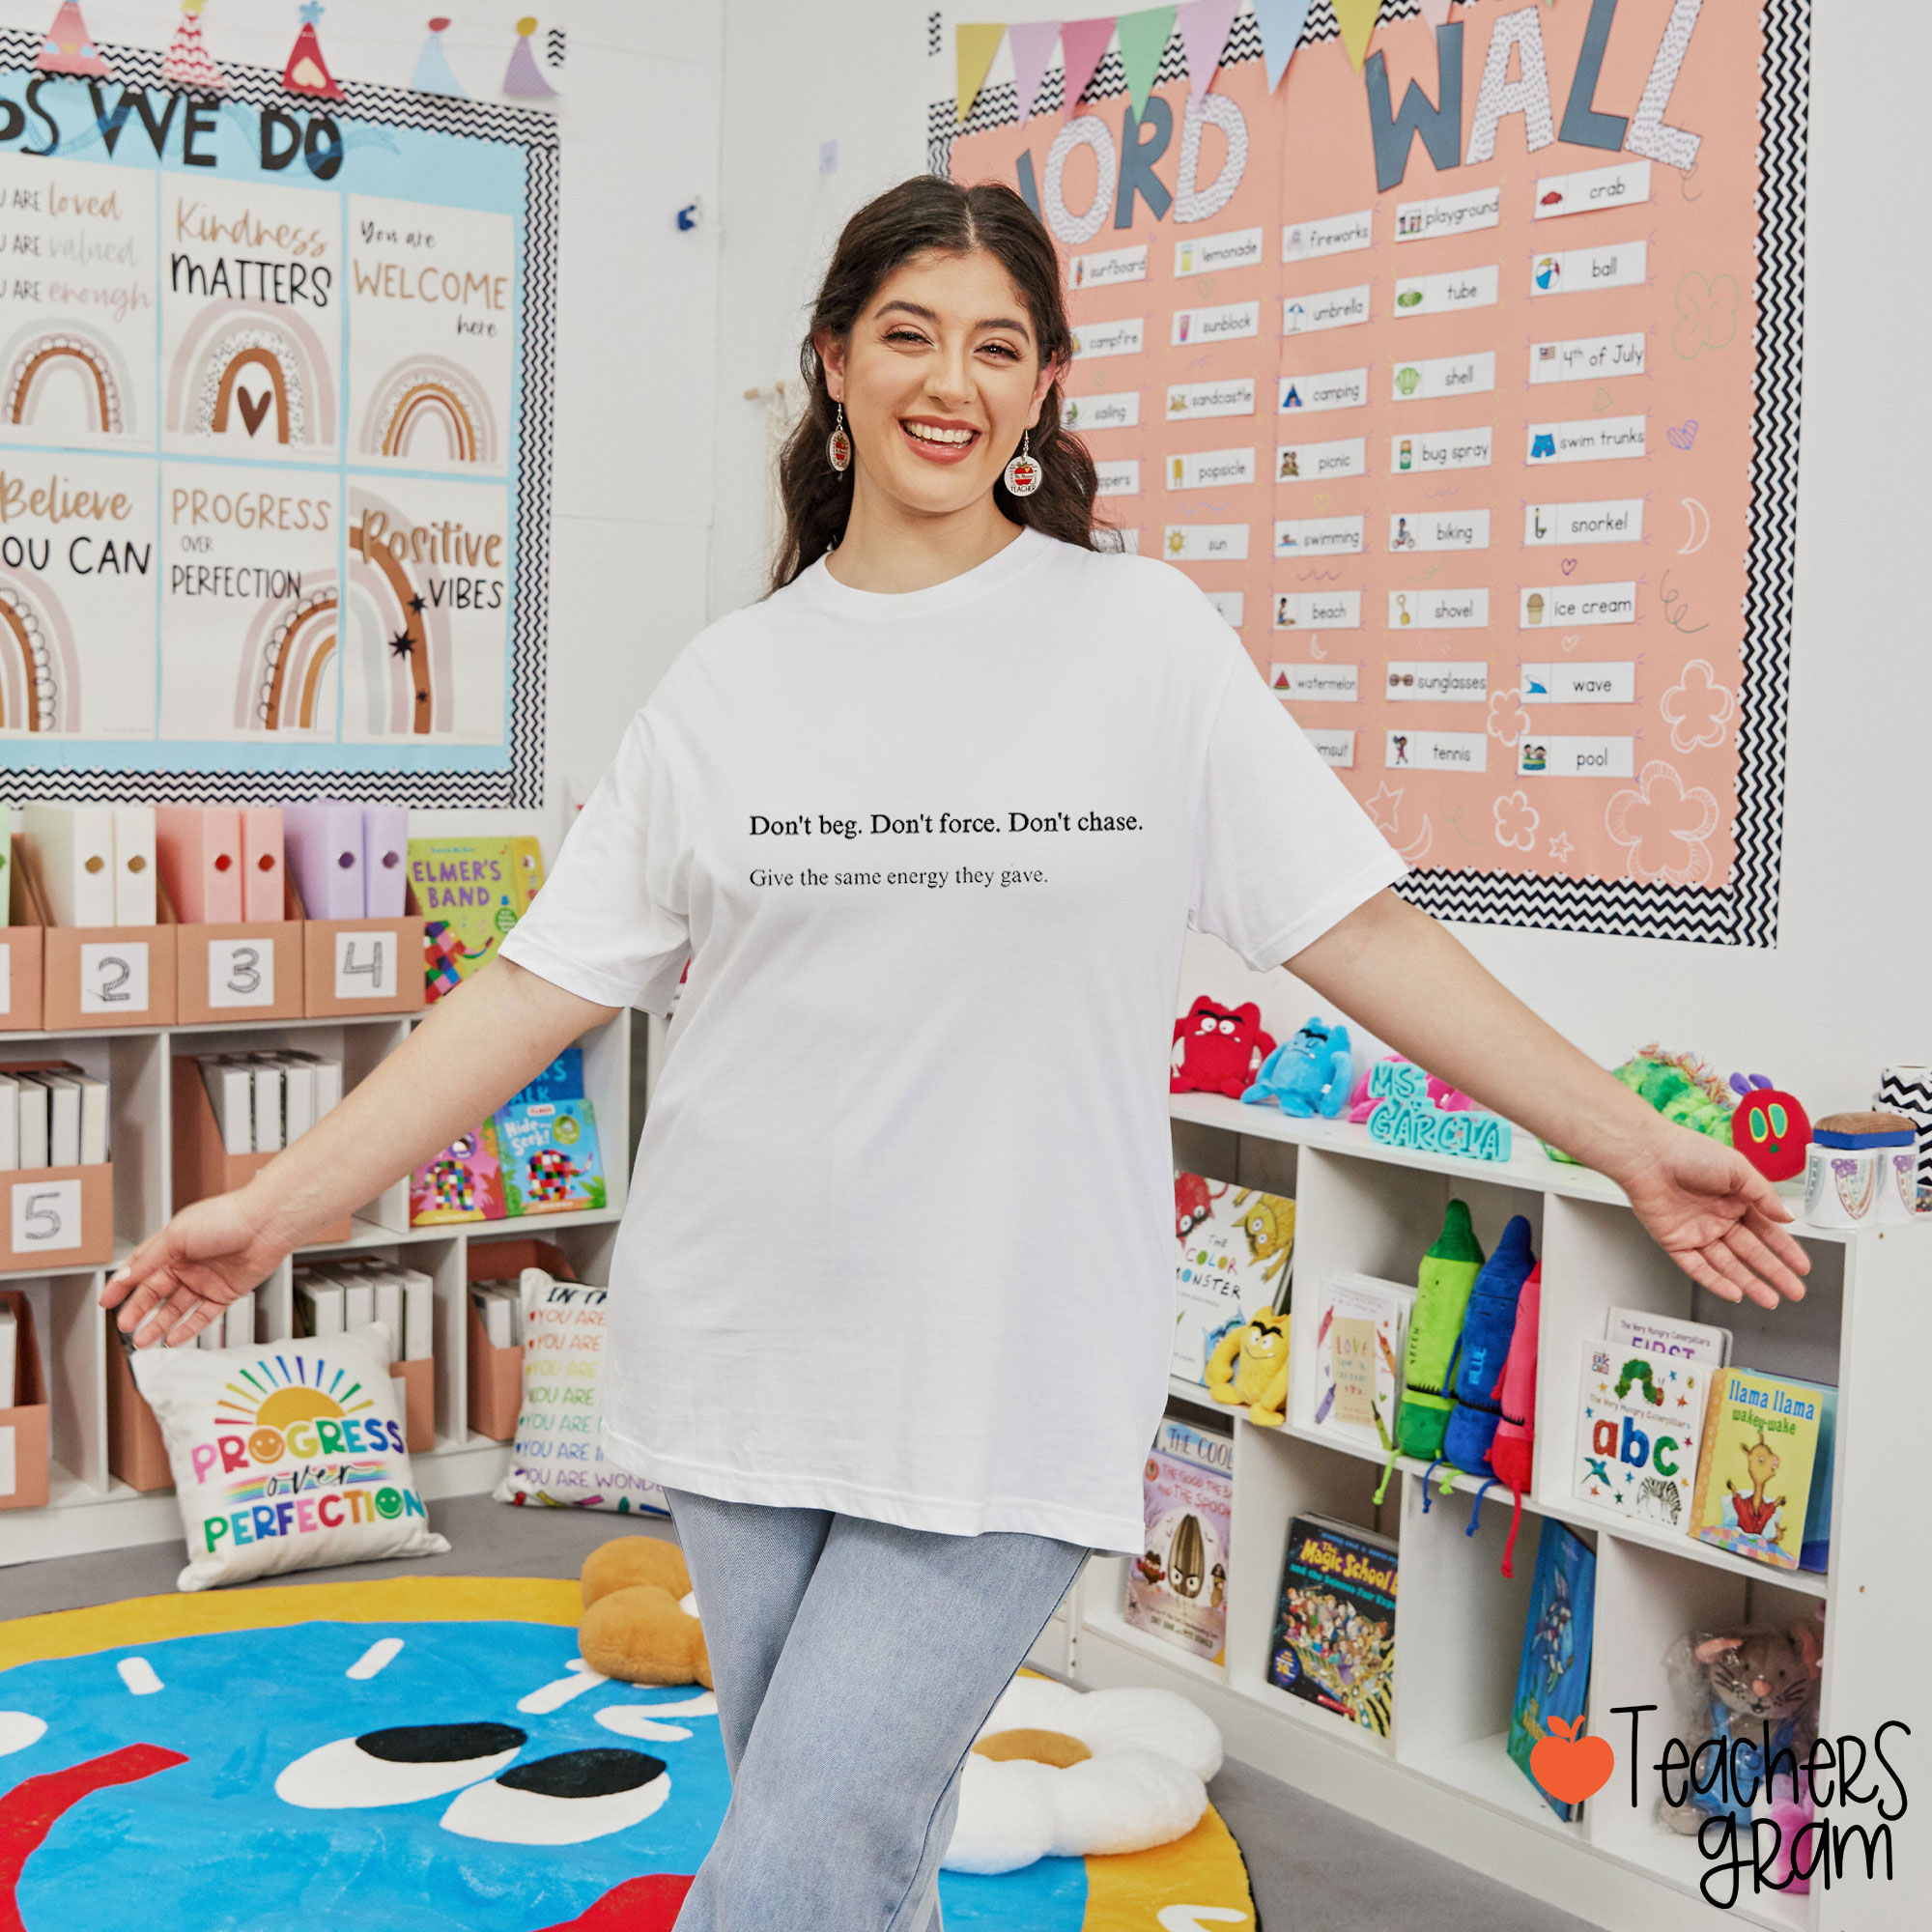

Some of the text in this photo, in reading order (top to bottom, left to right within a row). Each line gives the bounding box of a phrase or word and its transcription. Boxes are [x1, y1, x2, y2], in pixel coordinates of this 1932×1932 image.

[1364, 0, 1703, 192] WALL
[87, 81, 221, 168] WE
[260, 107, 344, 182] DO
[1589, 176, 1626, 200] crab
[14, 189, 42, 213] ARE
[48, 182, 122, 221] loved
[1425, 194, 1499, 229] playground
[177, 197, 327, 258] Kindness
[361, 220, 436, 248] You are
[1310, 223, 1369, 248] fireworks
[14, 235, 42, 258] ARE
[49, 229, 138, 268] valued
[1203, 239, 1258, 263] lemonade
[1090, 258, 1146, 279] surfboard
[1592, 256, 1618, 277] ball
[171, 252, 332, 307] MATTERS
[354, 258, 509, 311] WELCOME
[1447, 281, 1478, 301] tube
[14, 280, 42, 302] ARE
[48, 281, 151, 323] enough
[1313, 298, 1364, 322] umbrella
[457, 314, 497, 337] here
[1203, 312, 1252, 334] sunblock
[1090, 329, 1138, 350] campfire
[1563, 344, 1644, 368] 4th of July
[1445, 365, 1474, 386] shell
[1192, 389, 1253, 407] sandcastle
[1313, 382, 1360, 402] camping
[1094, 405, 1126, 422] sailing
[1559, 427, 1645, 449] swim trunks
[1318, 454, 1351, 473] picnic
[1422, 441, 1490, 465] bug spray
[1198, 459, 1247, 480] popsicle
[0, 470, 132, 525] Believe
[172, 488, 331, 531] PROGRESS
[1436, 523, 1473, 544] biking
[1571, 511, 1629, 533] snorkel
[181, 534, 213, 554] OVER
[362, 508, 502, 568] Positive
[1209, 539, 1228, 552] sun
[1304, 528, 1360, 549] swimming
[3, 536, 151, 575] OU CAN
[172, 564, 301, 600] PERFECTION
[429, 577, 504, 610] VIBES
[1312, 603, 1347, 620] beach
[1435, 599, 1474, 618] shovel
[1554, 599, 1633, 616] ice cream
[1297, 675, 1356, 691] watermelon
[1418, 670, 1487, 694] sunglasses
[1573, 678, 1612, 693] wave
[1315, 742, 1349, 757] imsuit
[1433, 744, 1472, 761] tennis
[1577, 748, 1608, 771] pool
[750, 811, 1144, 839] Don't beg. Don't force. Don't chase.
[412, 860, 502, 883] ELMER'S
[750, 867, 1048, 889] Give the same energy they gave.
[428, 887, 491, 909] BAND
[227, 947, 261, 994] 3
[343, 941, 383, 988] 4
[98, 956, 130, 1003] 2
[510, 1086, 552, 1104] ALK
[504, 1118, 538, 1140] Hide
[1370, 1103, 1502, 1159] GARCIA
[511, 1130, 550, 1156] Seek!
[25, 1191, 62, 1240] 5
[1209, 1234, 1229, 1248] THE
[1184, 1247, 1238, 1275] COLOR
[546, 1287, 578, 1304] IN
[538, 1308, 608, 1326] YOU ARE
[537, 1333, 604, 1352] YOU ARE
[1336, 1335, 1369, 1357] LOVE
[562, 1386, 595, 1406] ARE
[1728, 1378, 1815, 1421] llama llama
[526, 1413, 554, 1431] YOU
[558, 1414, 592, 1434] ARE
[1731, 1407, 1797, 1435] wakey-wake
[191, 1418, 405, 1485] PROGRESS
[523, 1439, 553, 1458] YOU
[556, 1441, 590, 1461] ARE
[1169, 1427, 1192, 1455] THE
[1593, 1415, 1680, 1478] abc
[267, 1464, 375, 1497] over
[555, 1469, 588, 1488] ARE
[204, 1487, 426, 1554] PERFECTION
[1299, 1538, 1344, 1574] Magic
[1342, 1552, 1393, 1592] School
